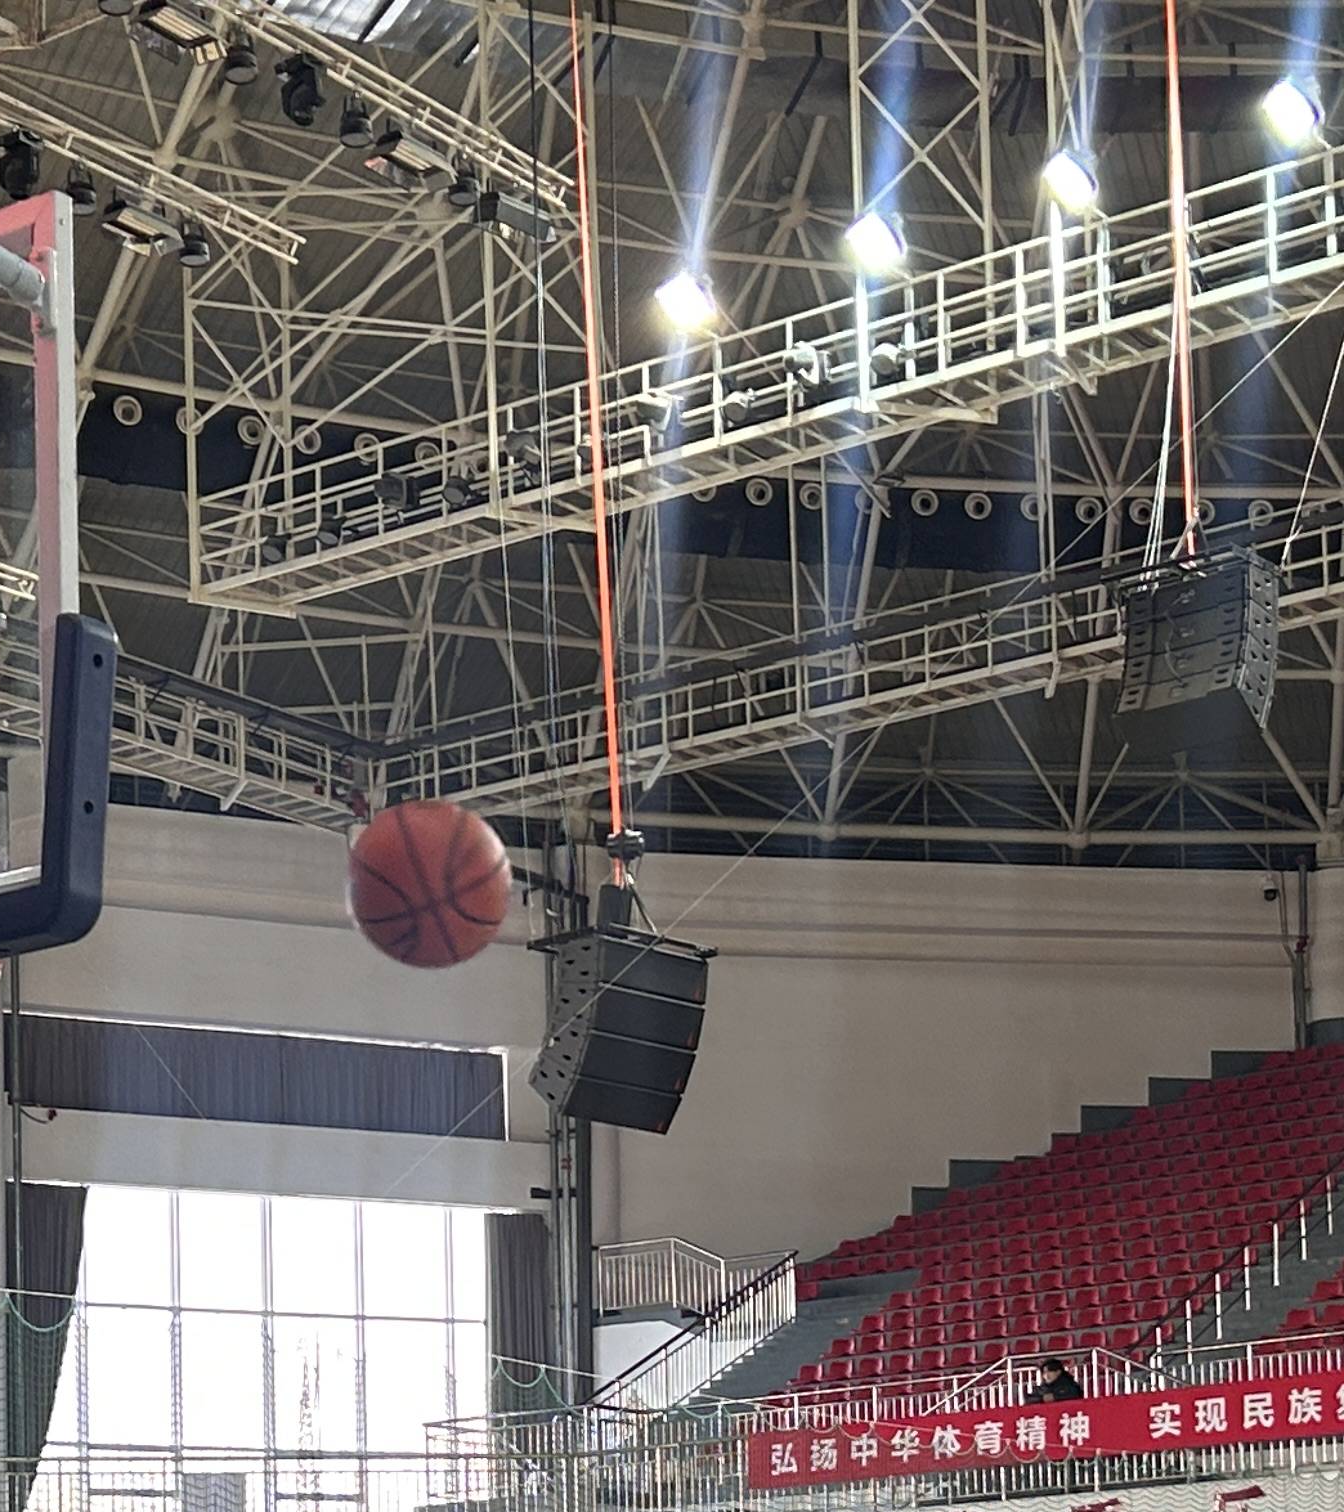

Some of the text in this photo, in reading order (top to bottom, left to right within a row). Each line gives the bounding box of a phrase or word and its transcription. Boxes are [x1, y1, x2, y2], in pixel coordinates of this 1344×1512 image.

[771, 1411, 1091, 1476] 弘扬中华体育精神
